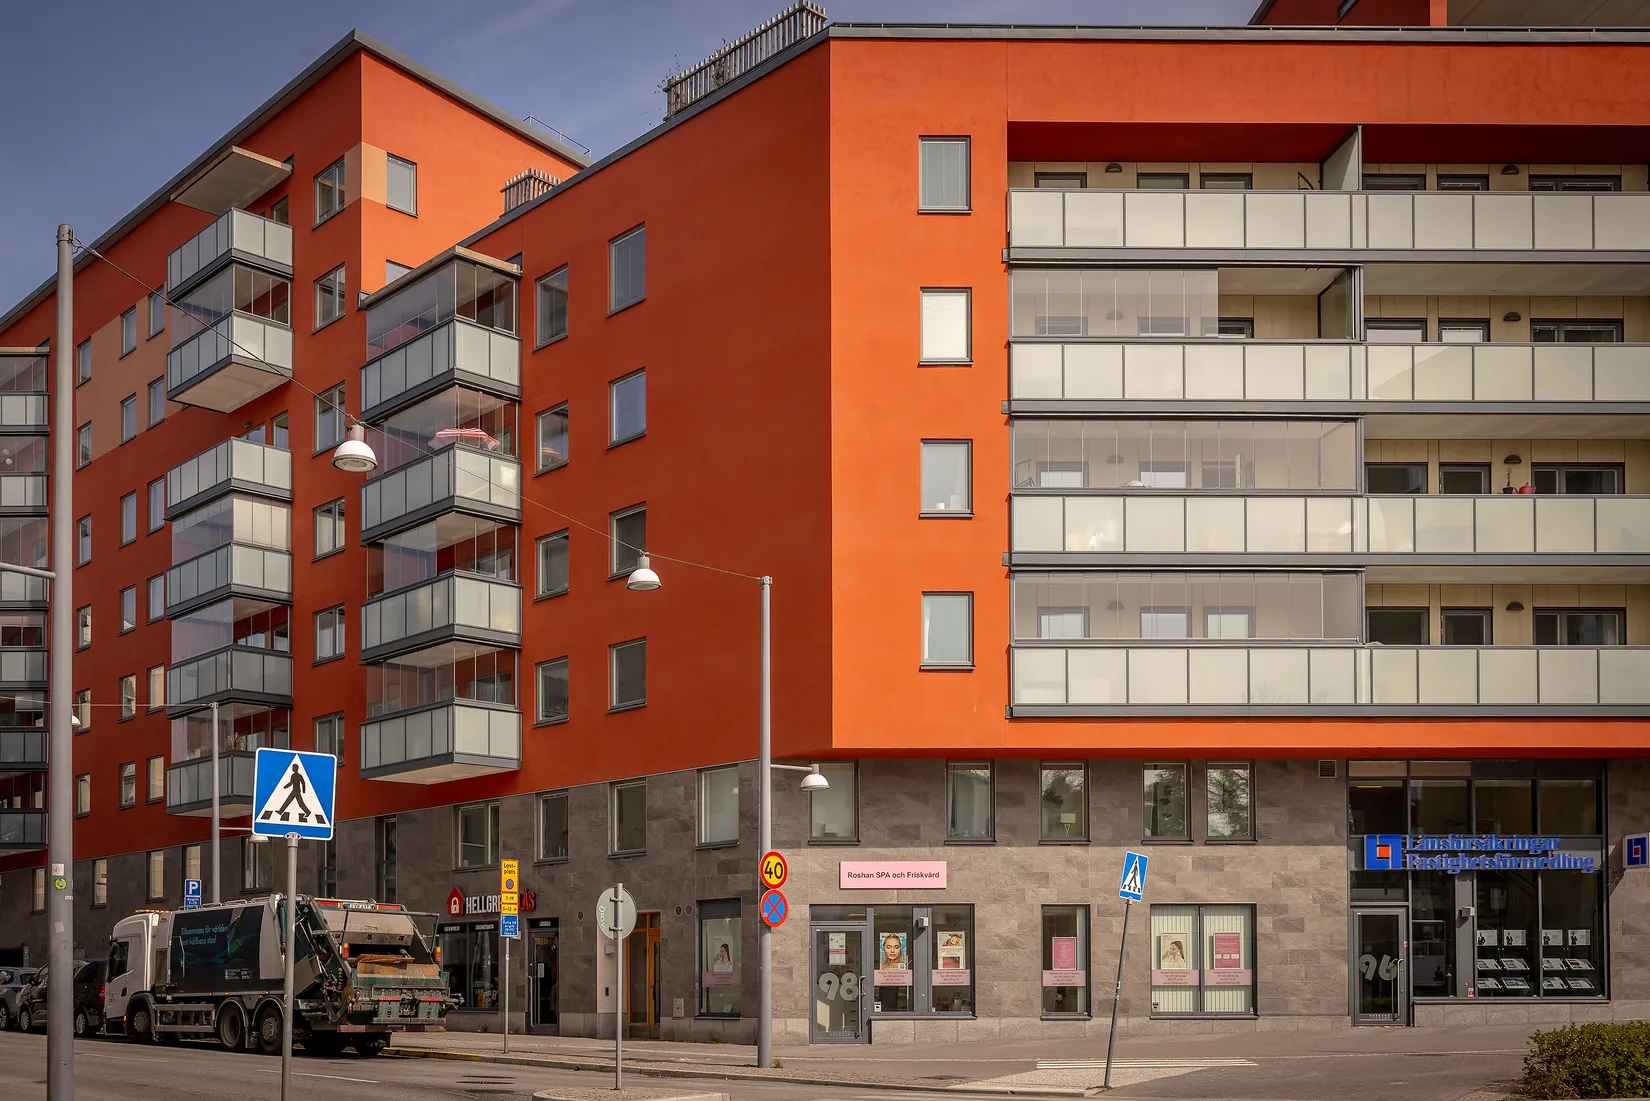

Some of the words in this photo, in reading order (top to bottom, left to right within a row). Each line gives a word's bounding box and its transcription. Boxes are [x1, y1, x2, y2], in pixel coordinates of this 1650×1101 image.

[1405, 834, 1561, 855] Länsförsäkringar
[764, 860, 784, 880] 40
[1405, 852, 1595, 874] Fastighetsförmedling
[847, 871, 874, 879] Roshan
[876, 871, 891, 879] SPA
[892, 871, 905, 879] och
[906, 871, 940, 879] Friskvård
[189, 881, 199, 895] P
[1358, 954, 1398, 981] 96
[818, 972, 859, 1001] 98
